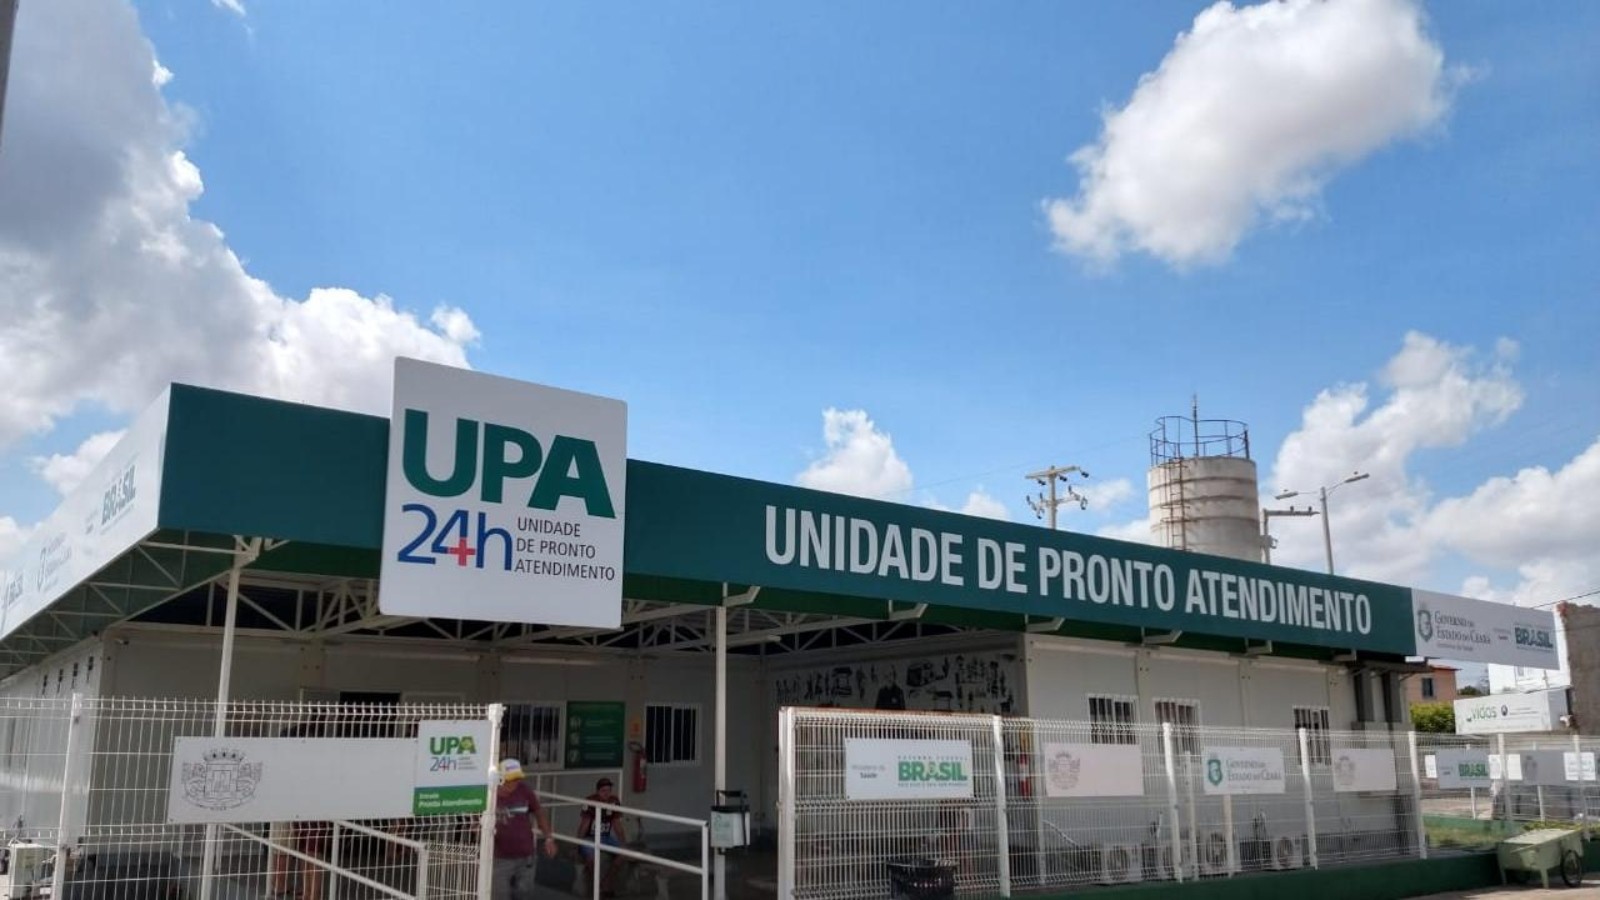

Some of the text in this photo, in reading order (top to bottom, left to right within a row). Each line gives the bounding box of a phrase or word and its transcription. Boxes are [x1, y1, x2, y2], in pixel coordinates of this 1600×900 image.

[402, 408, 616, 519] UPA
[397, 503, 513, 572] 24h
[517, 516, 581, 538] UNIDADE
[516, 537, 596, 560] DE PRONTO
[514, 558, 616, 581] ATENDIMENTO
[764, 504, 1372, 636] UNIDADE DE PRONTO ATENDIMENTO
[1514, 627, 1554, 648] BRASIL
[429, 736, 477, 755] UPA
[429, 756, 457, 772] 24h
[898, 760, 968, 781] BRASIL
